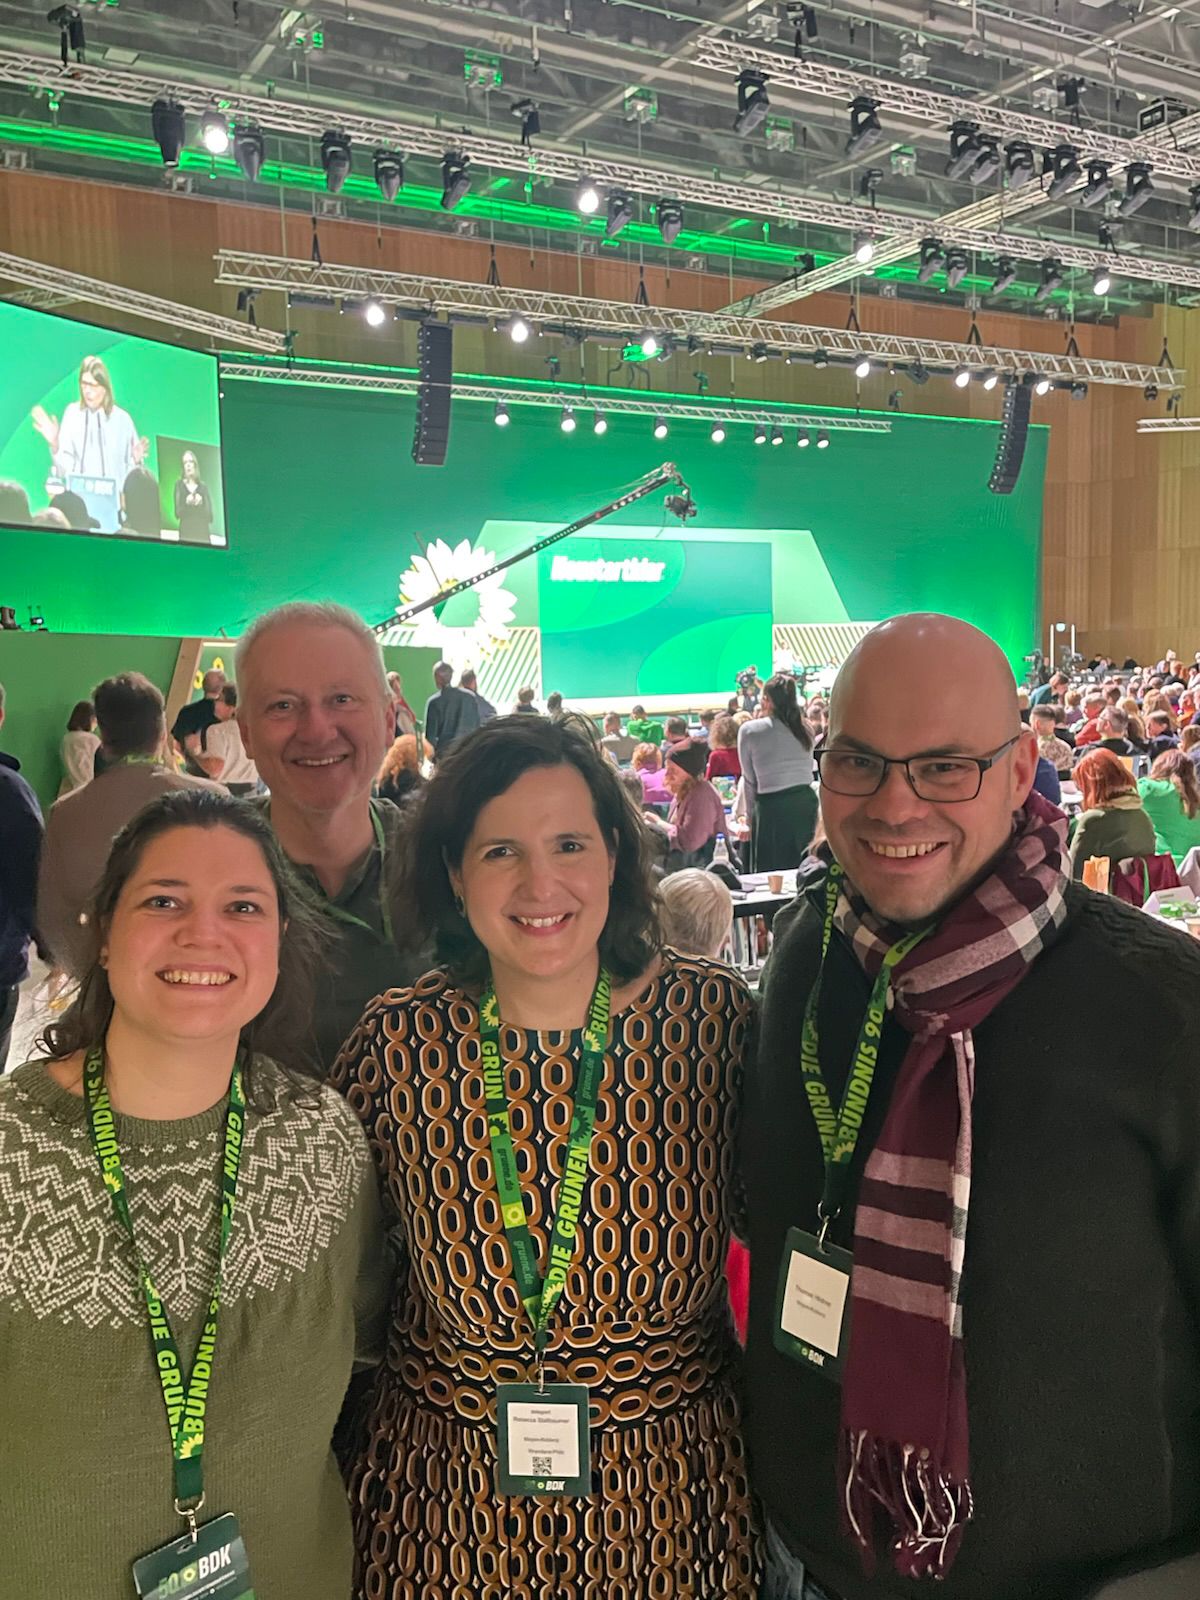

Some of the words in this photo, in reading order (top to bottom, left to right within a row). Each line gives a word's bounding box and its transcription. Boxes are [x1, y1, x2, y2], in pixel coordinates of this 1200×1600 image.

[482, 1040, 505, 1100] GRÜN
[801, 1040, 822, 1075] DIE
[837, 1042, 877, 1142] BÜNDNIS
[864, 1008, 883, 1038] 90
[556, 1145, 589, 1239] GRÜNEN
[513, 1240, 535, 1285] gruene.de
[547, 1244, 572, 1281] DIE
[148, 1301, 170, 1340] DIE
[181, 1322, 217, 1433] BÜNDNIS
[545, 1480, 566, 1491] BDK
[198, 1543, 232, 1580] BDK
